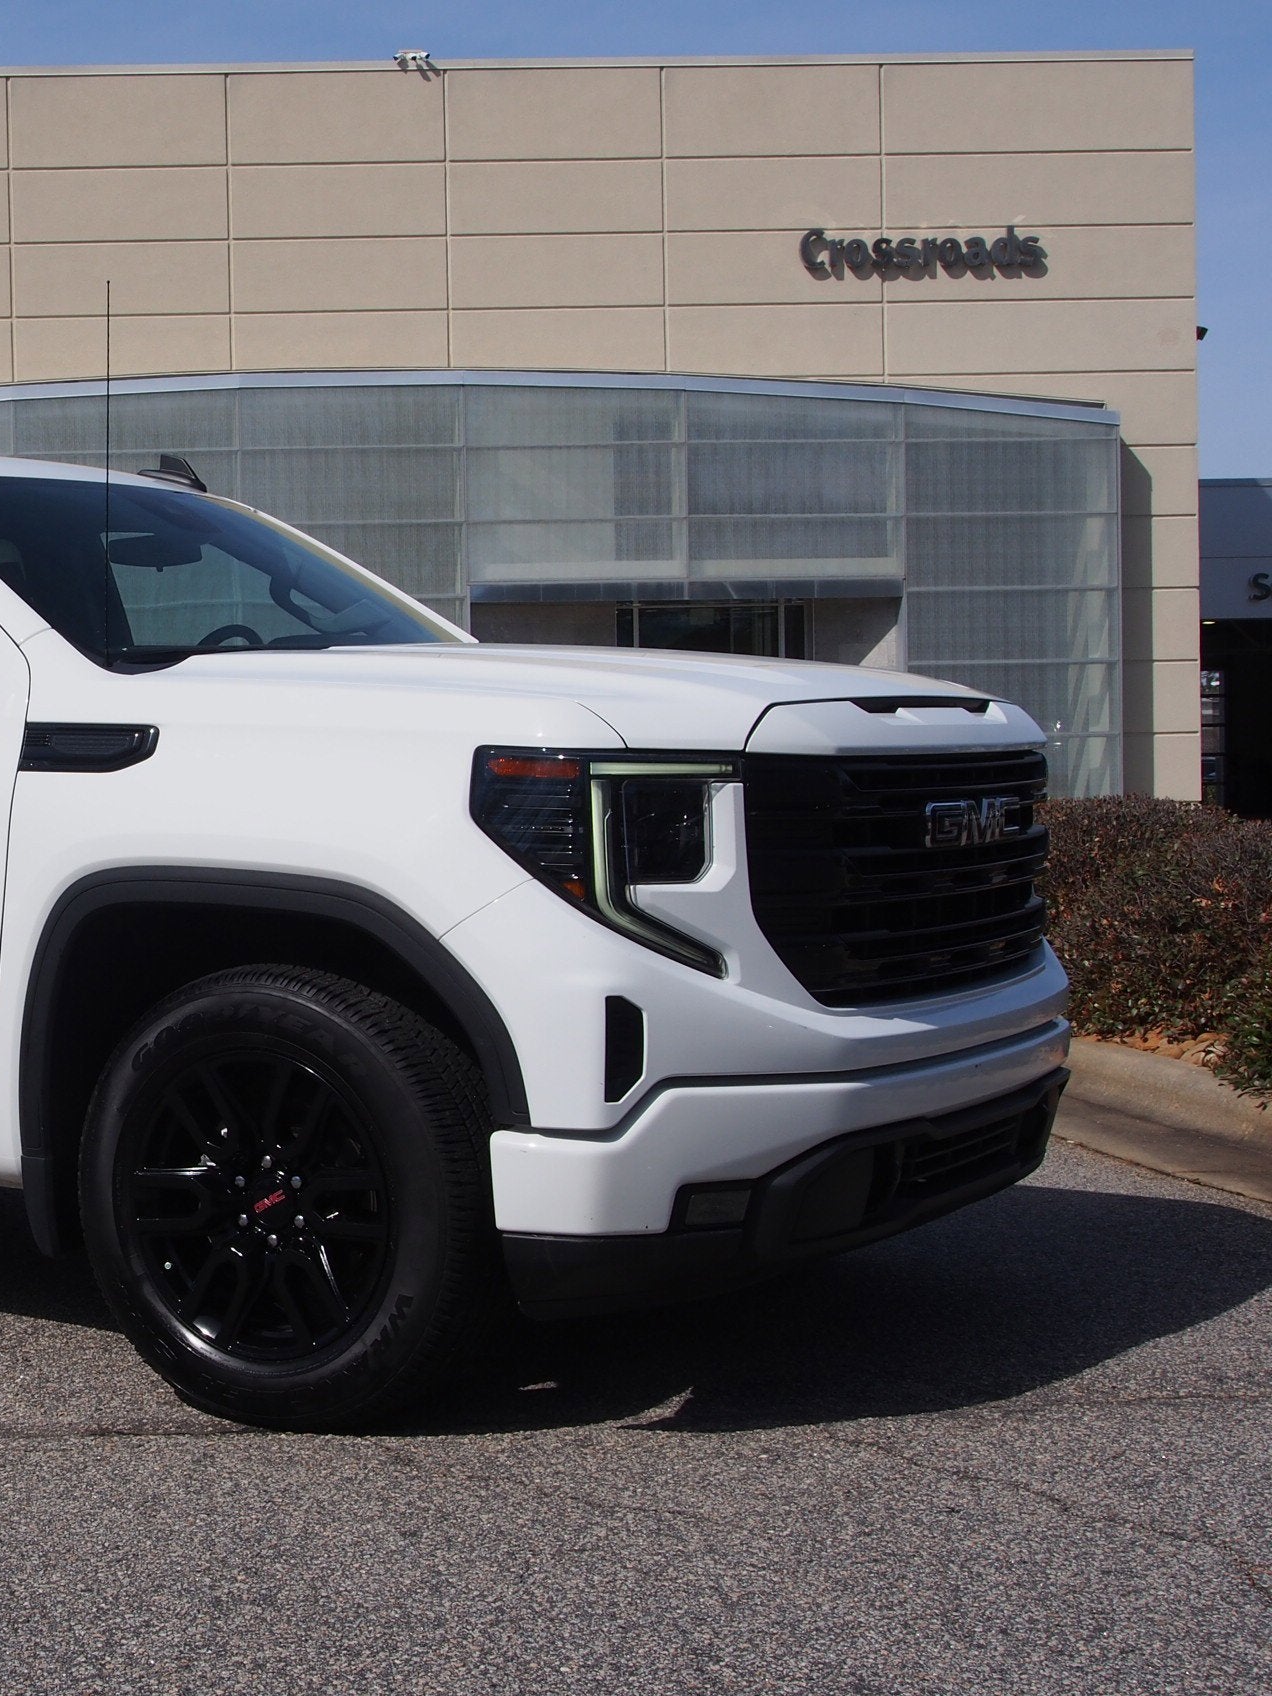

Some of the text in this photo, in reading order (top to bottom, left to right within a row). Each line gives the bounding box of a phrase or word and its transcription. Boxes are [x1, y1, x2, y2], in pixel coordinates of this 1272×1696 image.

[799, 225, 1041, 270] Crossroads
[925, 797, 1020, 848] GMC
[254, 1189, 286, 1213] GMC
